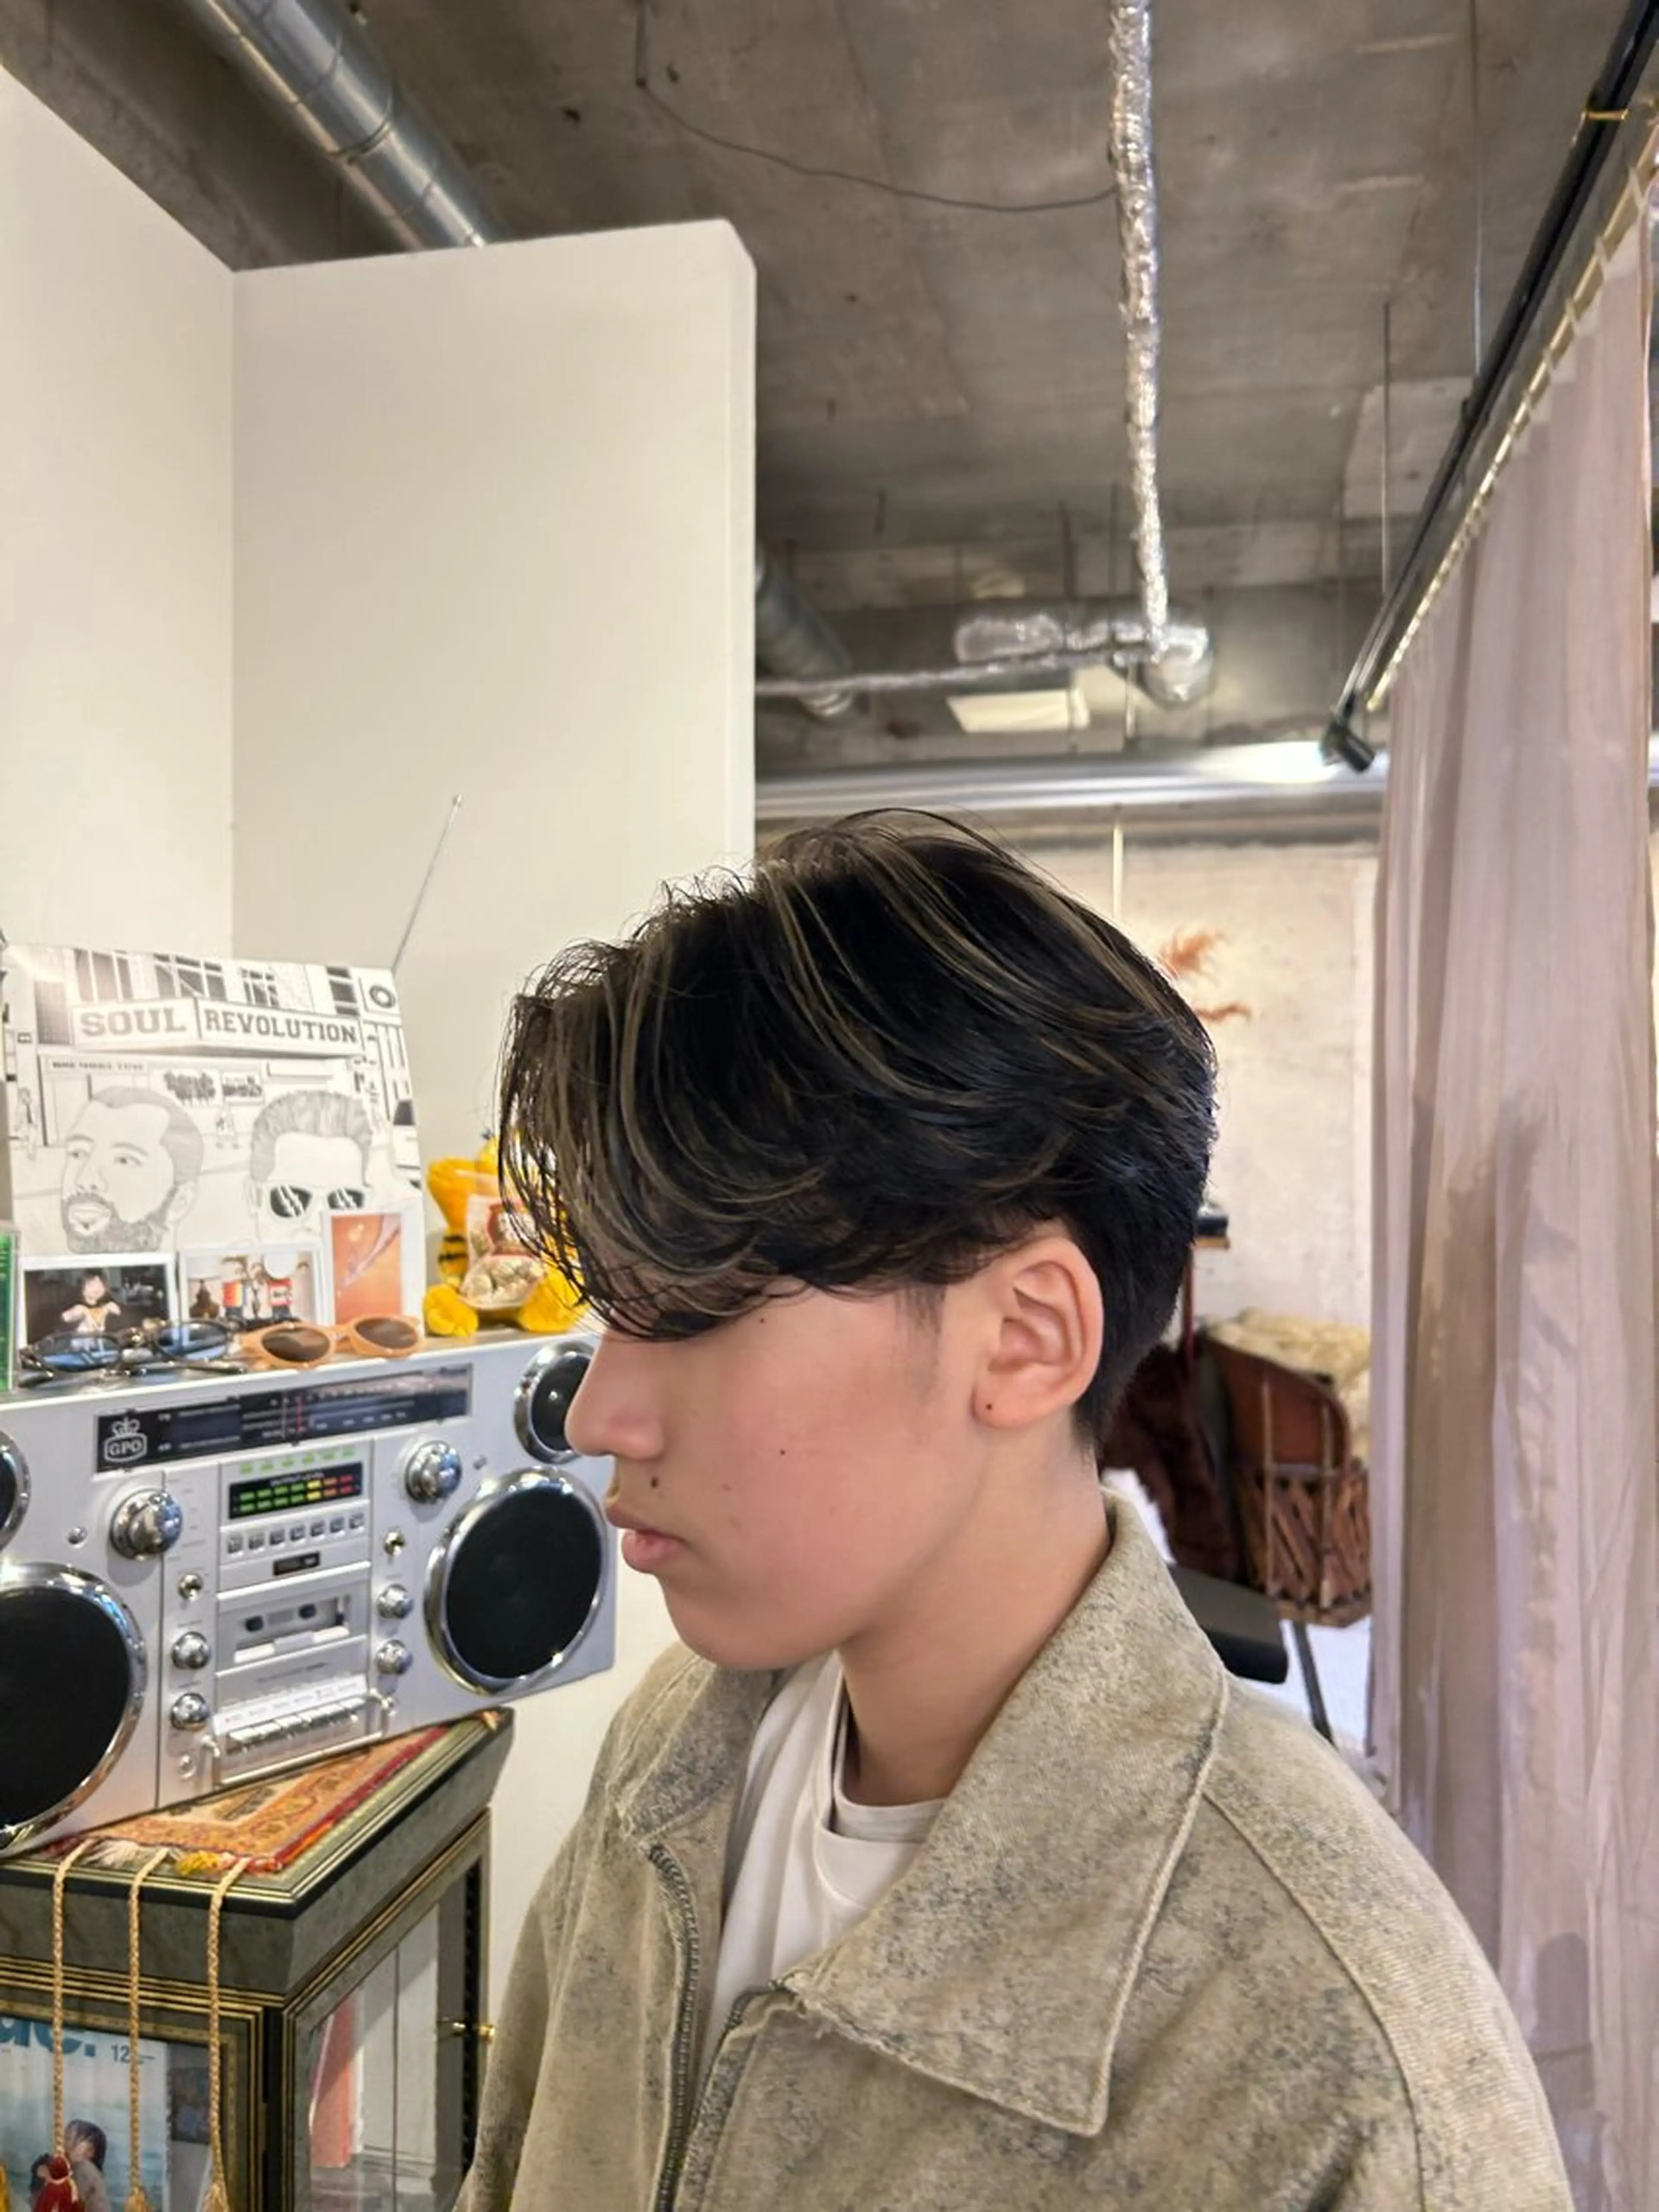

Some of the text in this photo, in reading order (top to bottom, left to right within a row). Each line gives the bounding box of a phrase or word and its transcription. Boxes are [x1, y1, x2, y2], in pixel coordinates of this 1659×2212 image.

[79, 1007, 358, 1043] SOUL REVOLUTION
[108, 1440, 143, 1456] GPO
